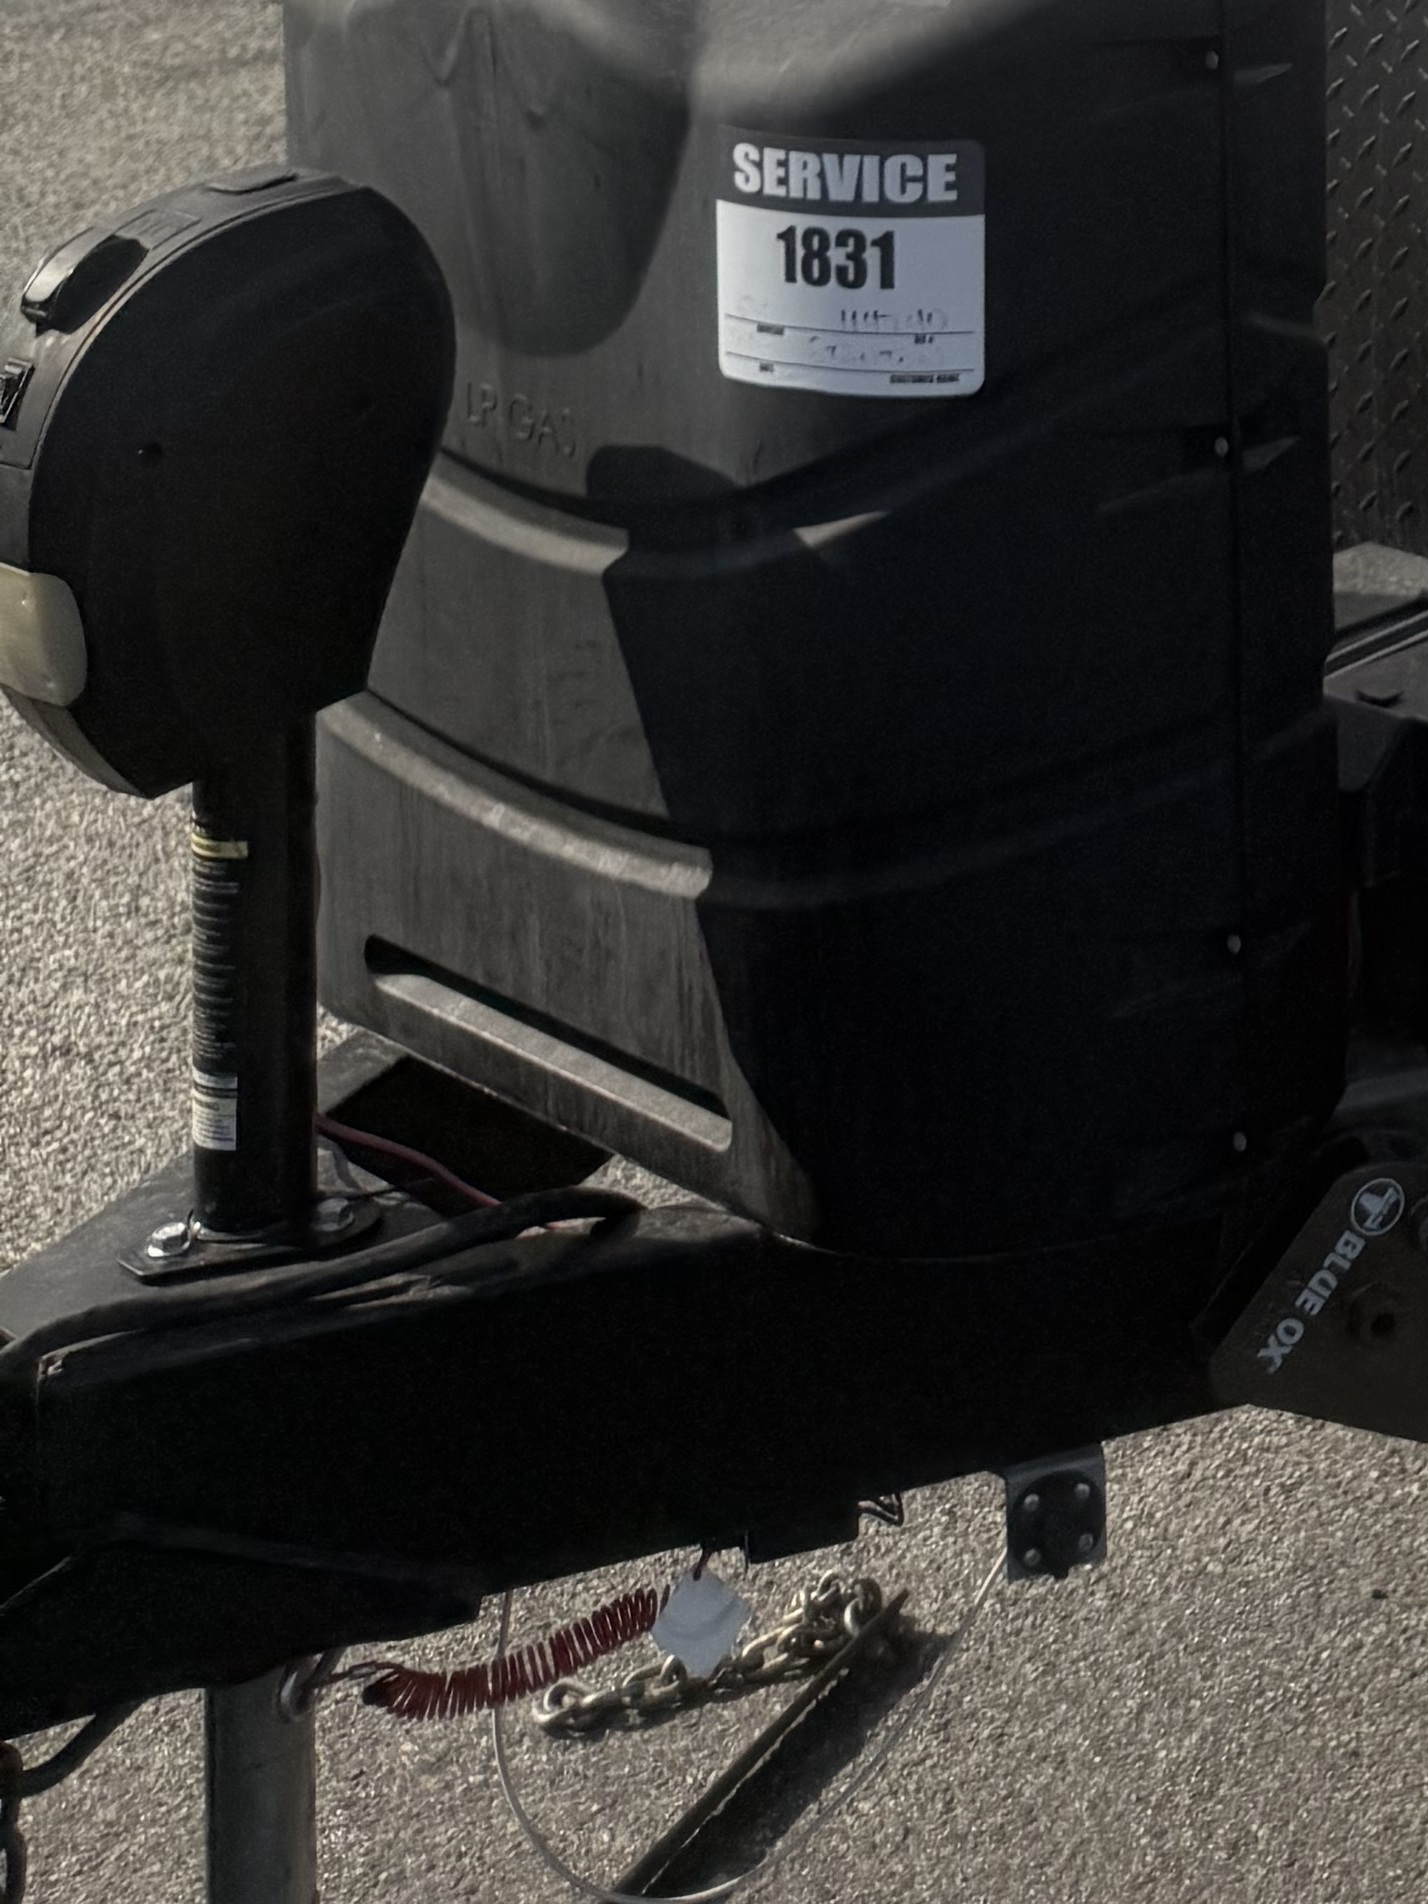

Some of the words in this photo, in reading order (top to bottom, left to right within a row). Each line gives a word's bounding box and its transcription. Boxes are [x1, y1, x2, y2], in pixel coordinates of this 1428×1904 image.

[732, 142, 958, 204] SERVICE
[776, 225, 895, 290] 1831
[1294, 1229, 1367, 1316] BLUE
[1256, 1317, 1305, 1374] OX
